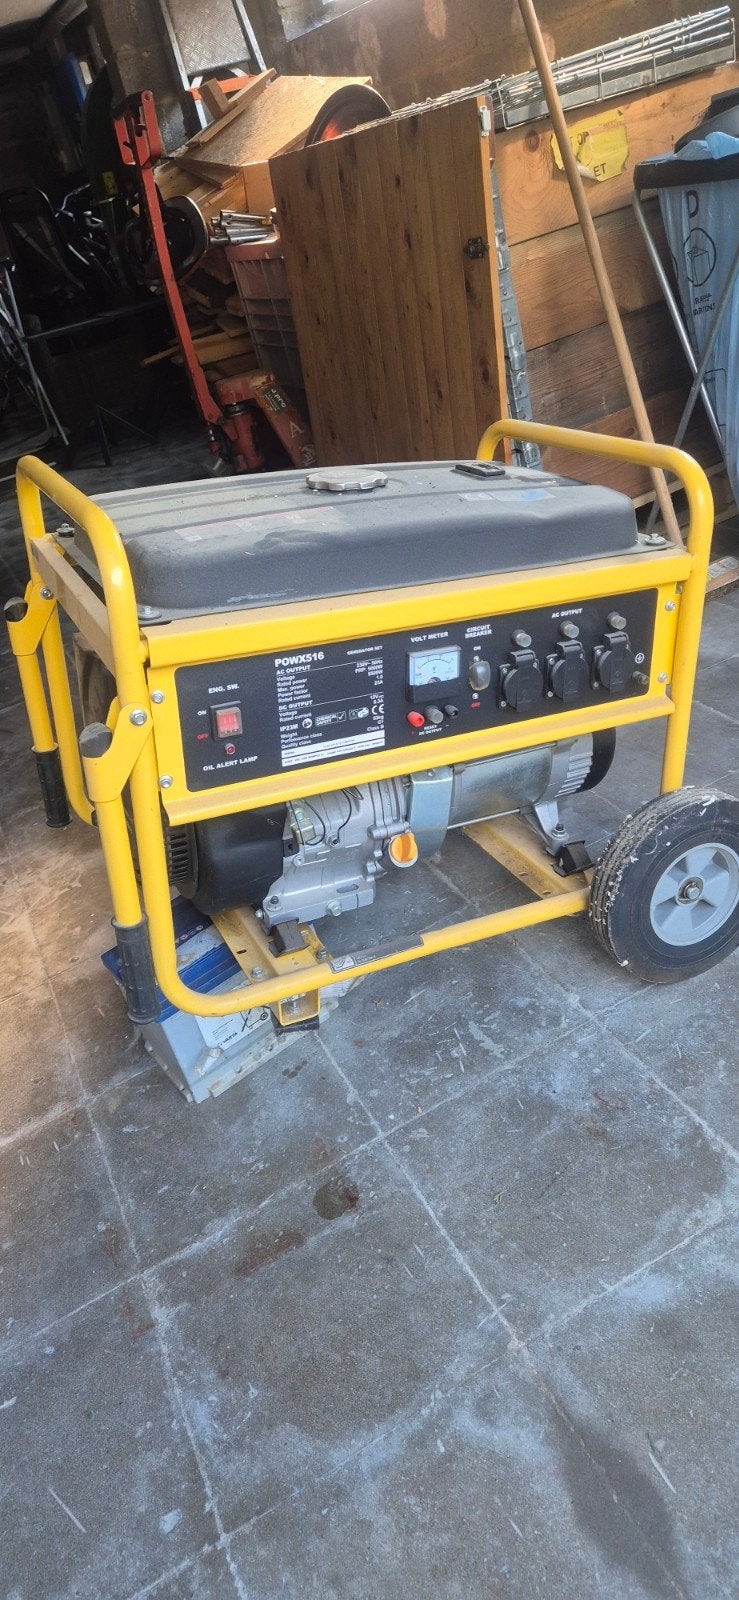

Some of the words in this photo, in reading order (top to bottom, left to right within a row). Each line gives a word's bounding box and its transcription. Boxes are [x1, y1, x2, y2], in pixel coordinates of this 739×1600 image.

[560, 608, 583, 617] OUTPUT
[466, 624, 491, 633] CIRCUIT
[411, 635, 427, 643] VOLT
[428, 631, 449, 640] METER
[465, 629, 492, 639] BREAKER
[274, 651, 325, 668] POWX516
[286, 664, 311, 674] OUTPUT
[277, 680, 292, 688] Rated
[208, 686, 226, 694] ENG.
[293, 693, 311, 701] current
[288, 700, 313, 709] OUTPUT
[279, 715, 294, 723] Rated
[294, 712, 312, 720] current
[280, 742, 298, 750] Quality
[216, 759, 239, 769] ALERT
[239, 755, 258, 764] LAMP
